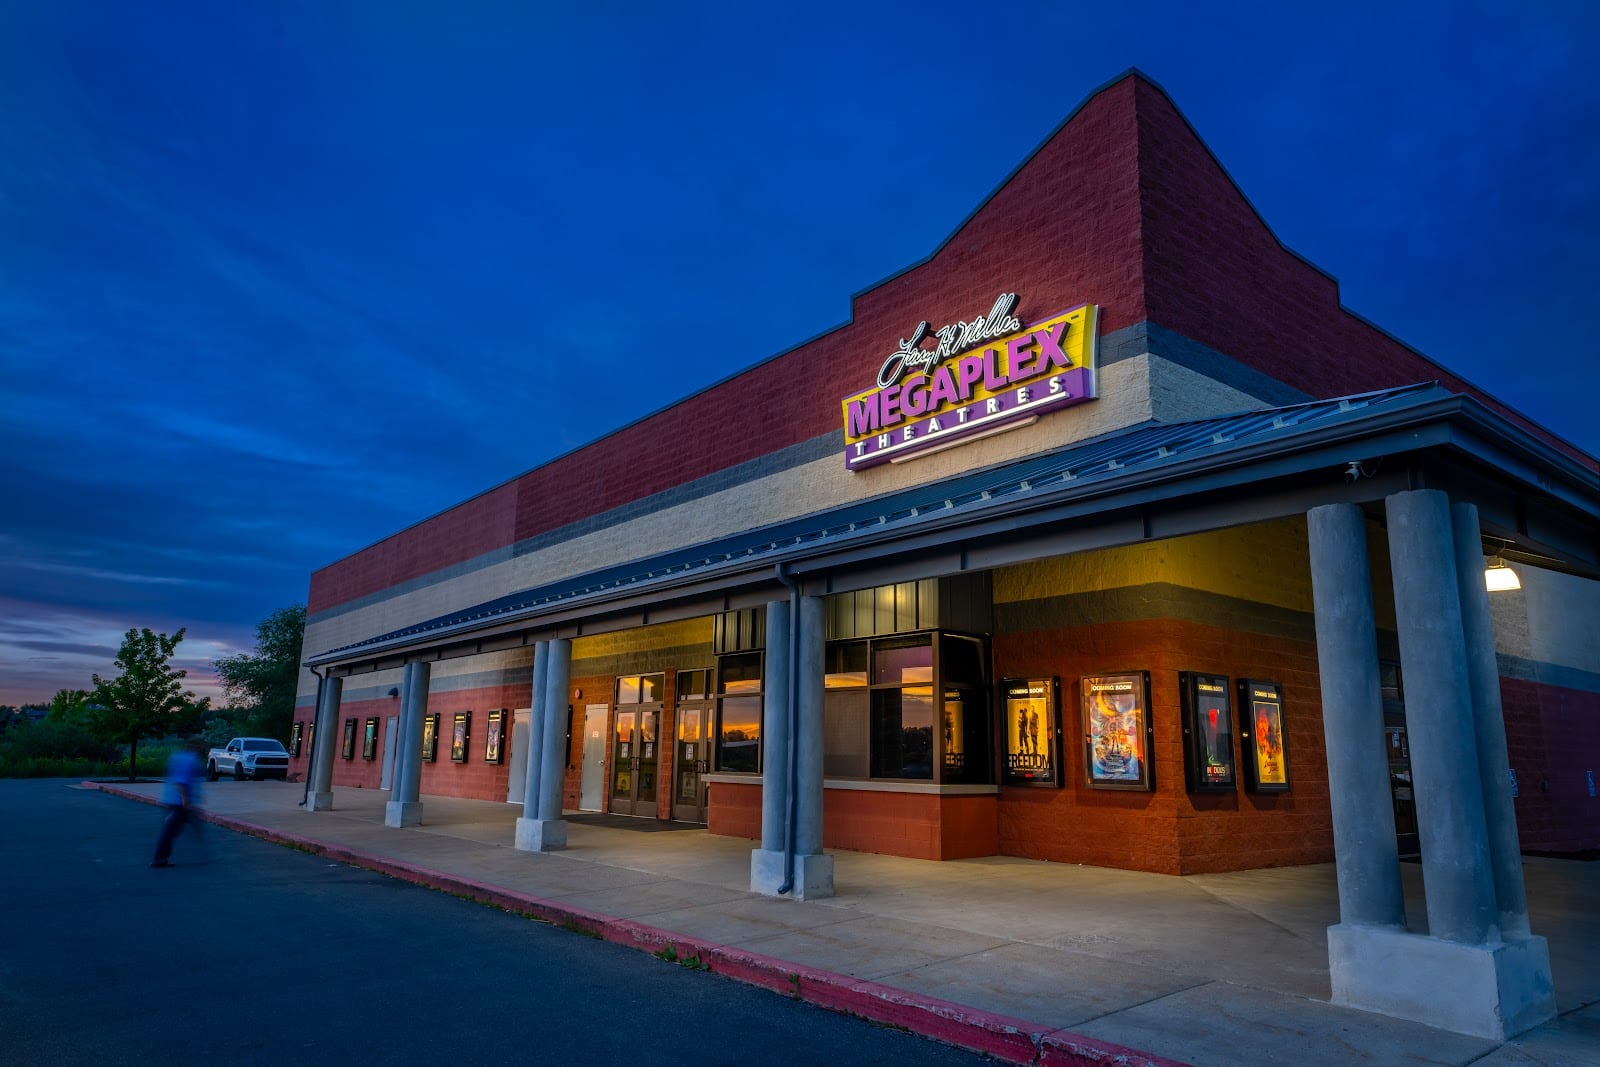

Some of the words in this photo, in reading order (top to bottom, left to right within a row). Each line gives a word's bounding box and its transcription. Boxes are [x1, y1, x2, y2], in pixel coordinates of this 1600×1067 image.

[952, 292, 1020, 353] Miller
[847, 321, 1071, 438] MEGAPLEX
[855, 376, 1064, 456] THEATRES
[1007, 753, 1051, 769] FREEDOM
